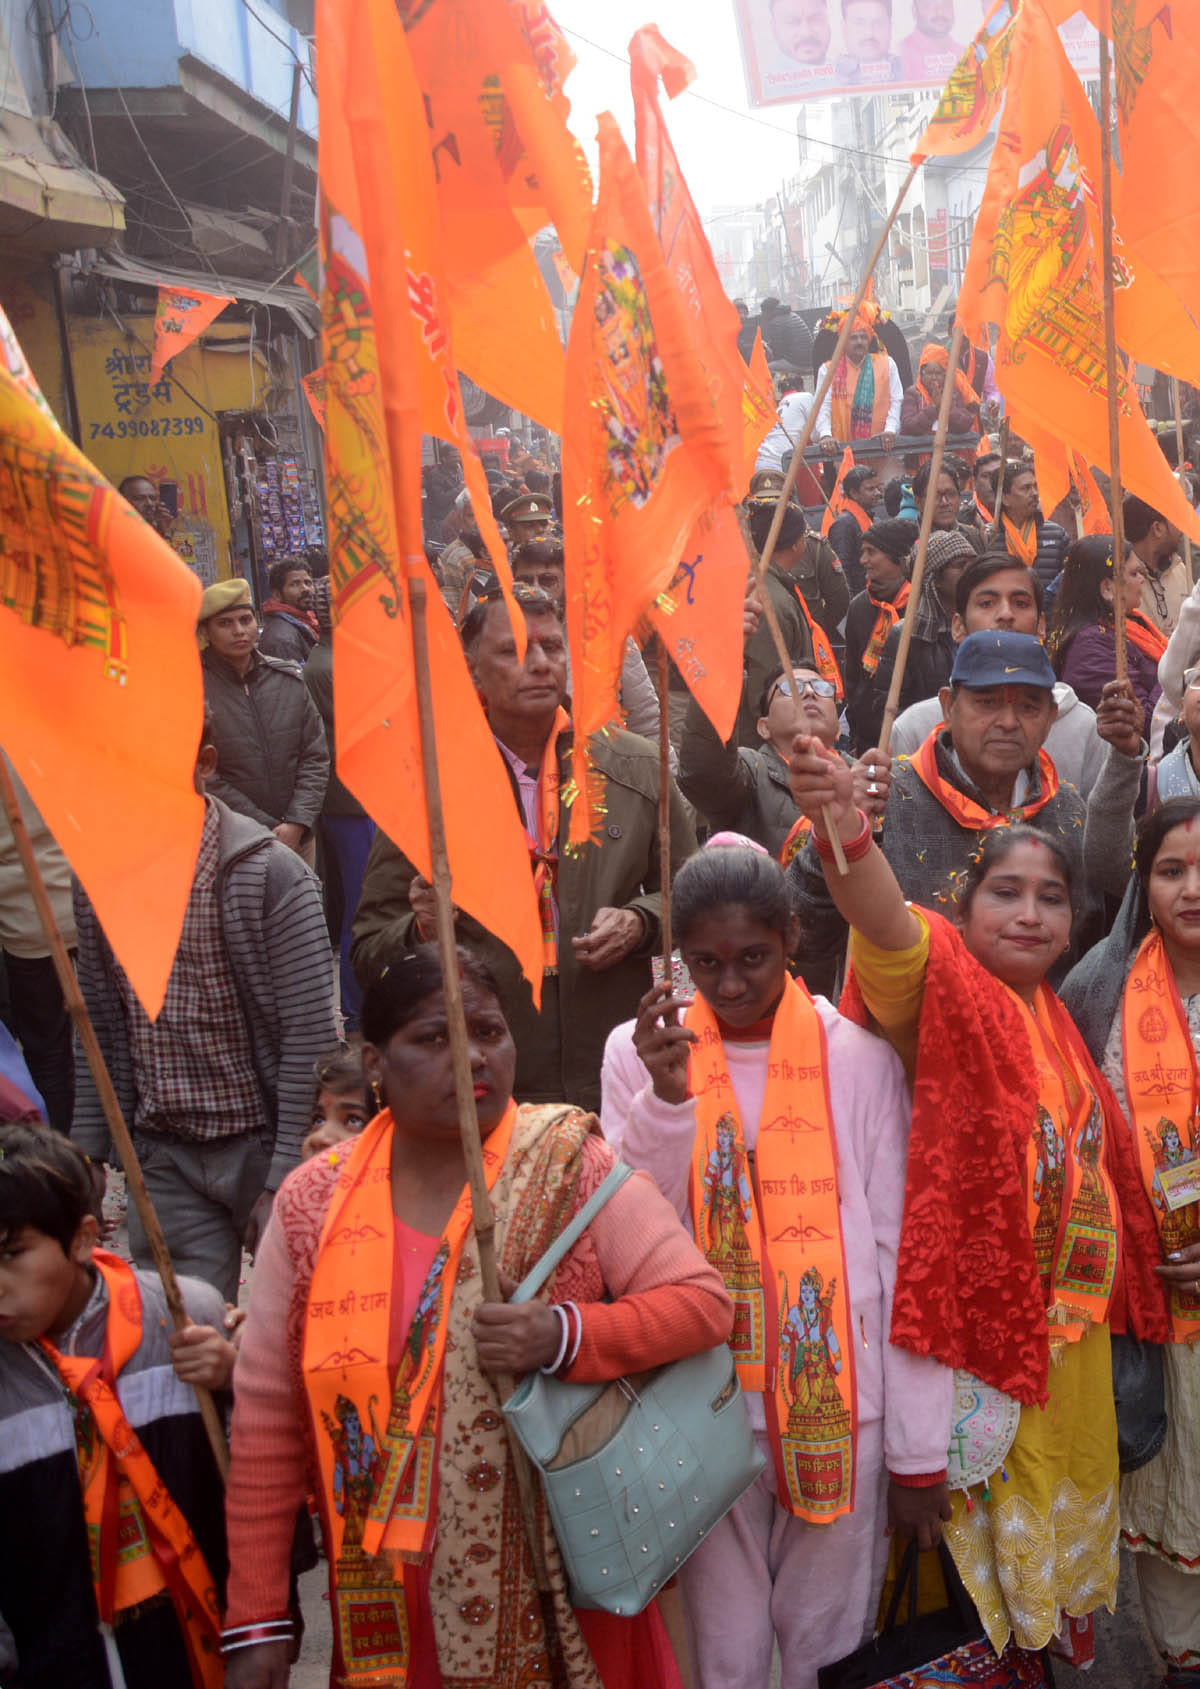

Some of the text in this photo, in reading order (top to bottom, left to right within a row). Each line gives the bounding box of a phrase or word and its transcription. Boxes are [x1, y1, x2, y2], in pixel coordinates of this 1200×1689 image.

[89, 415, 204, 440] 7499087399
[310, 1290, 388, 1320] जय श्री राम
